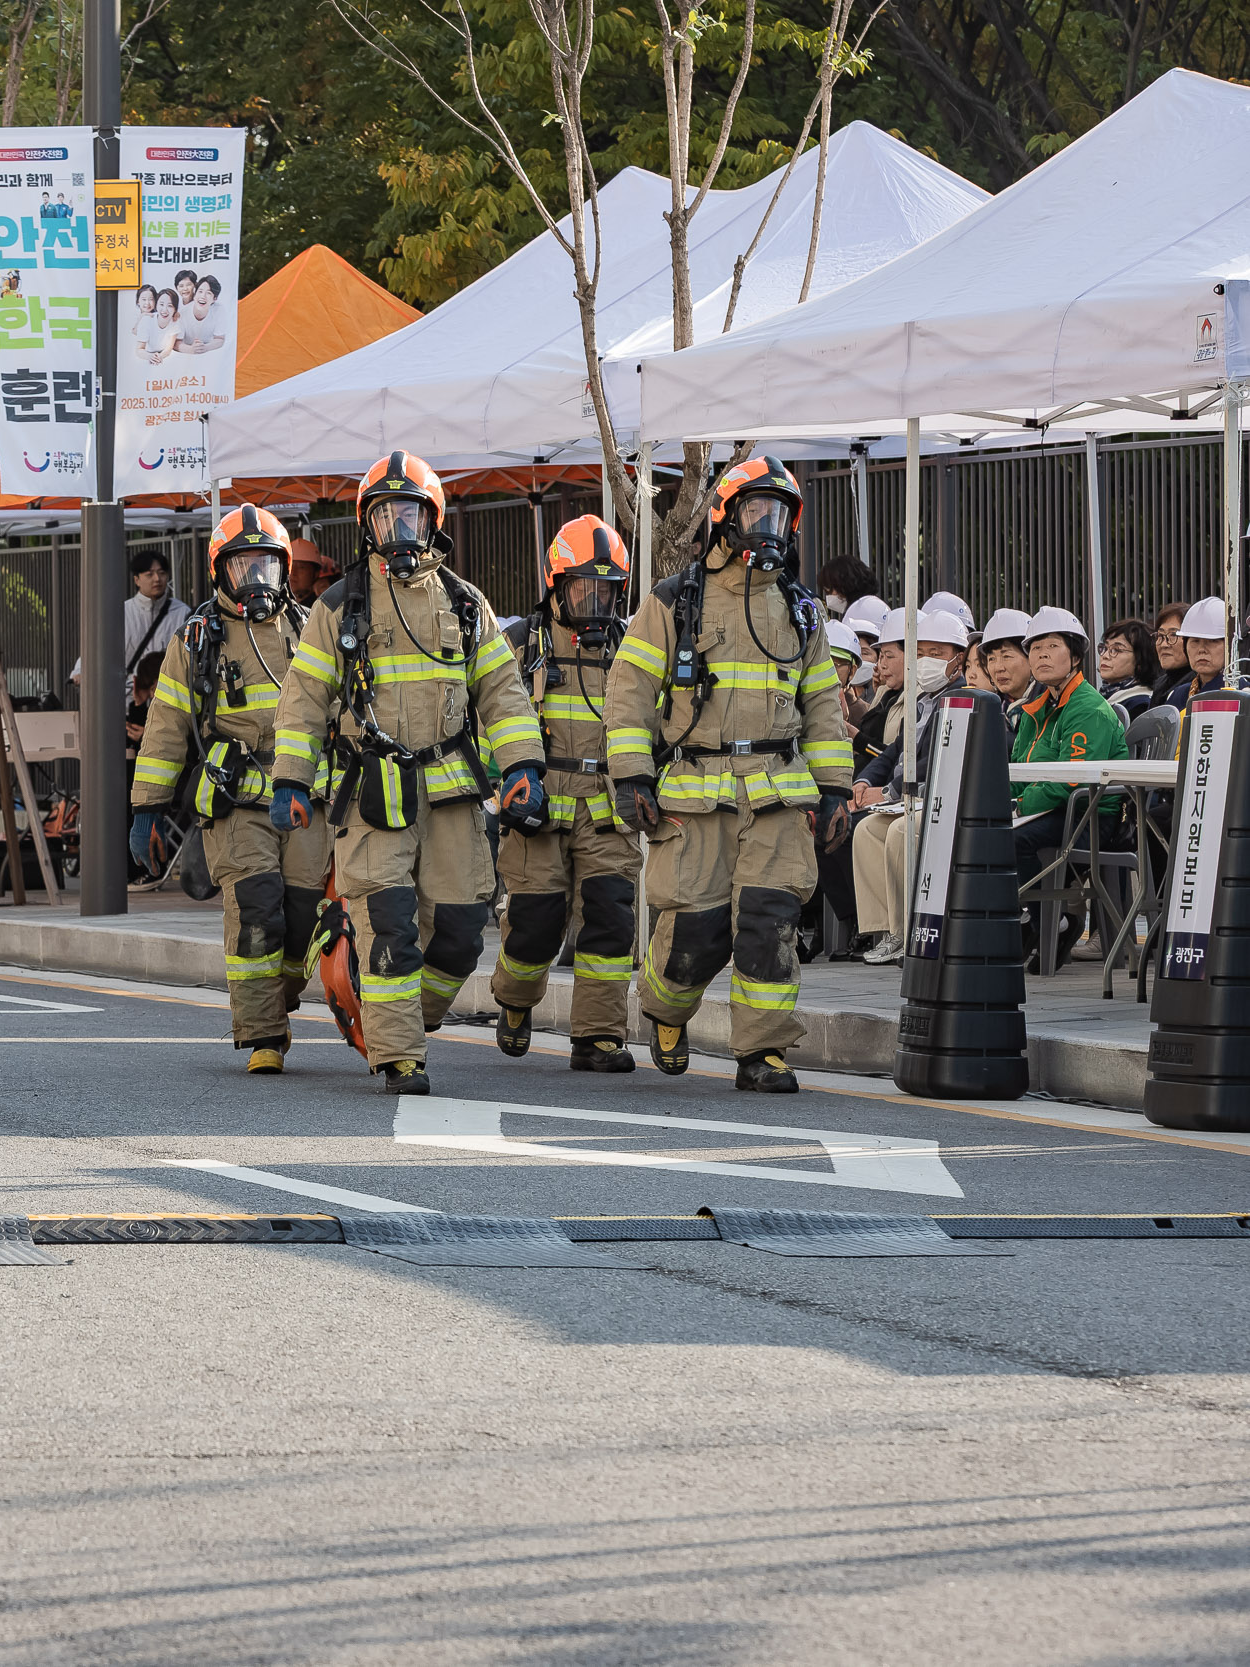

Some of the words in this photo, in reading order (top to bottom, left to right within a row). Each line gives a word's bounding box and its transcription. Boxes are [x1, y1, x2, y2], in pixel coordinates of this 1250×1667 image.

[26, 173, 54, 188] 함께
[159, 172, 233, 187] 재난으로부터
[142, 195, 180, 212] 민의
[184, 193, 233, 213] 생명과
[142, 220, 180, 238] 산을
[184, 219, 231, 238] 지키는
[142, 243, 230, 264] 난대비훈련
[96, 257, 136, 272] 속지역
[1, 368, 92, 423] 훈련
[1180, 724, 1214, 919] 통합지원본부
[1175, 946, 1204, 964] 광진구
